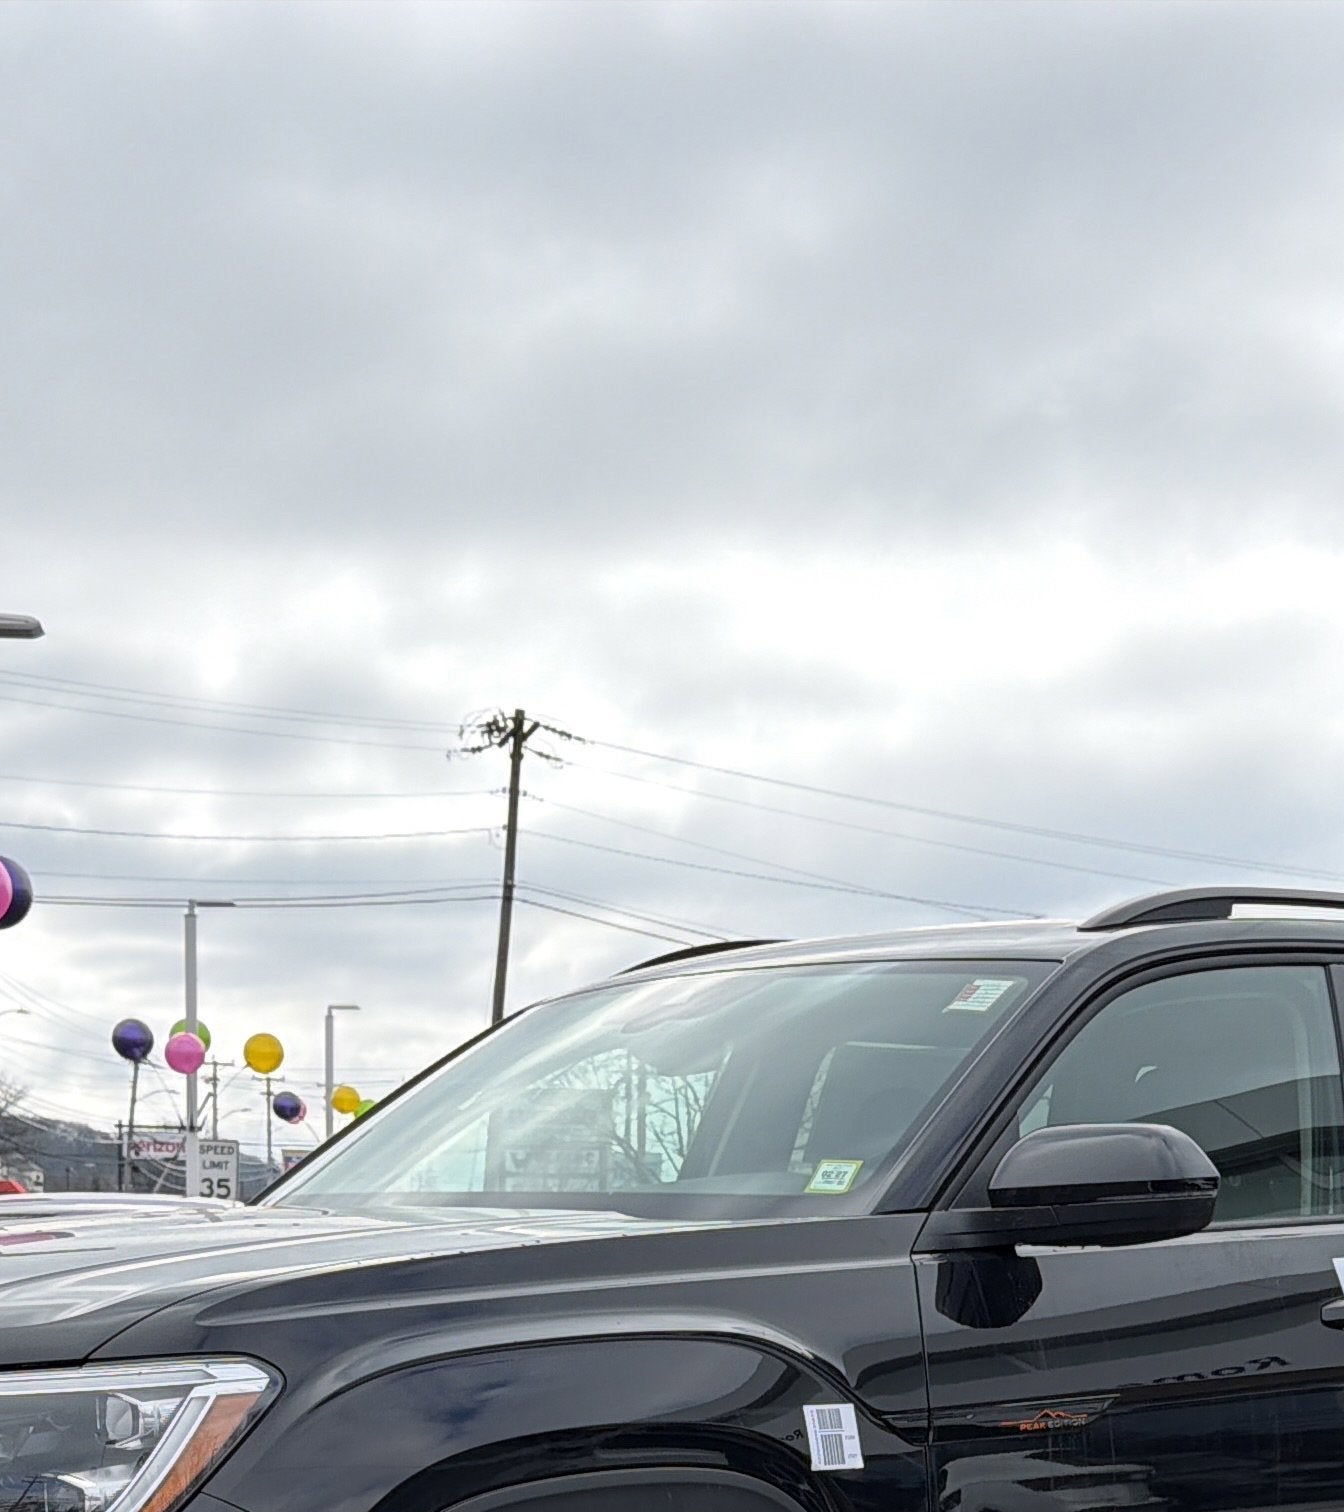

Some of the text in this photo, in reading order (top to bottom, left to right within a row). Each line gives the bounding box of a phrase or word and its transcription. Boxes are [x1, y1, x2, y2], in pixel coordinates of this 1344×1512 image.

[199, 1144, 234, 1155] SPEED
[203, 1160, 229, 1171] LIMIT
[200, 1178, 231, 1198] 35
[1019, 1417, 1087, 1431] PEAK EDITION
